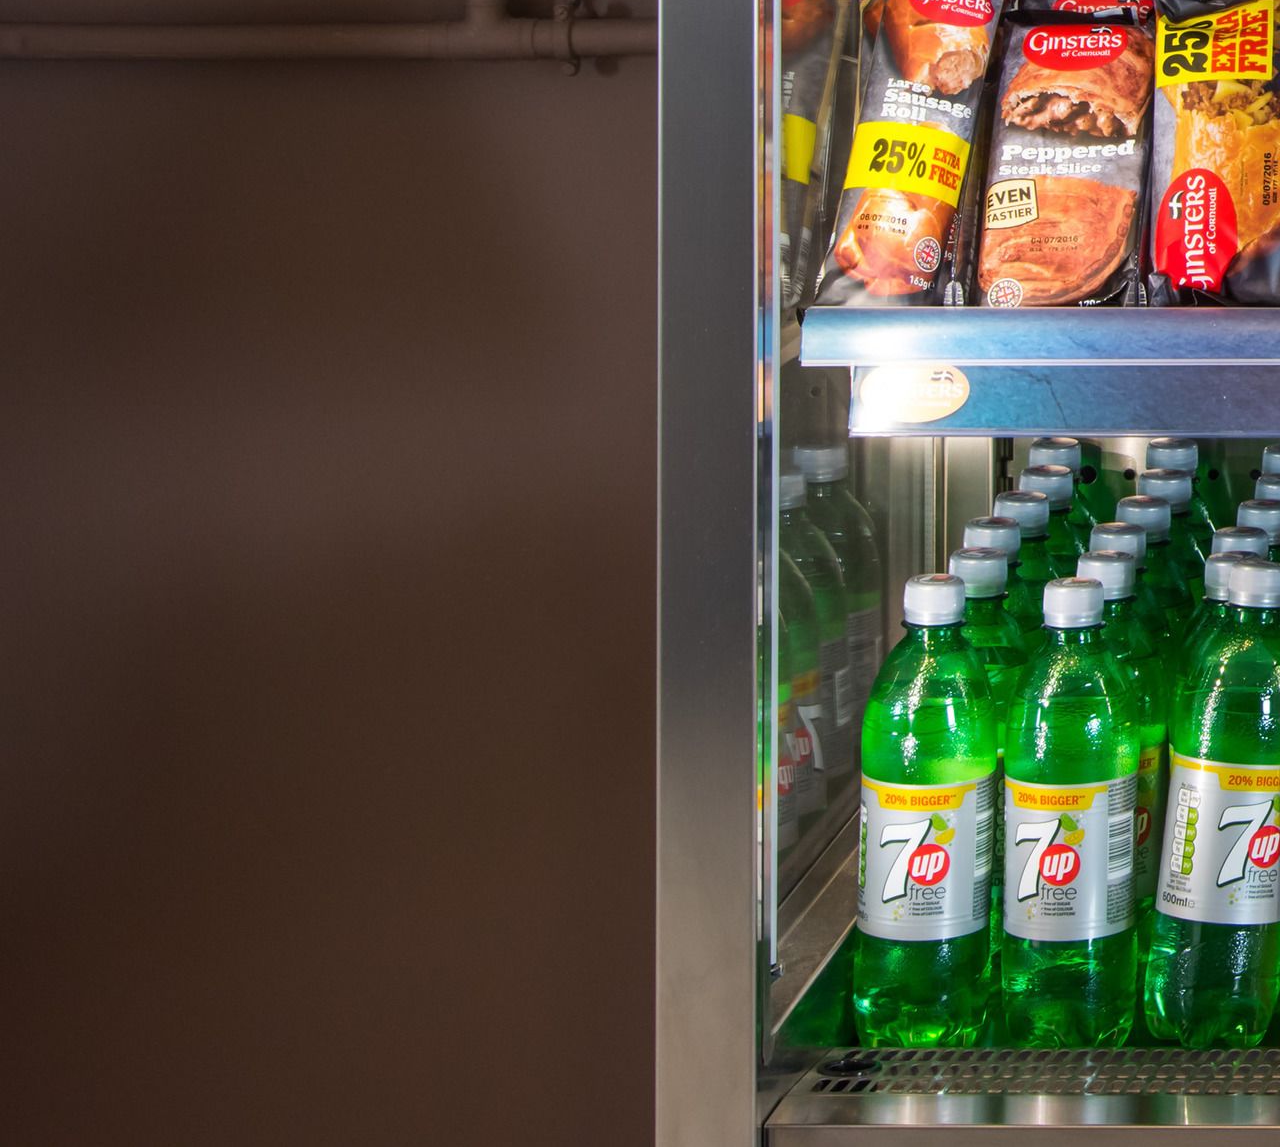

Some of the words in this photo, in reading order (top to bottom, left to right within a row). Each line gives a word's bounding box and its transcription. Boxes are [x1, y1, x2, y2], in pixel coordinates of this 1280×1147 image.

[951, 4, 984, 20] Cornwall
[887, 78, 930, 92] Large
[884, 87, 972, 120] Sausage
[881, 103, 926, 121] Roll
[869, 137, 926, 180] 25%
[1001, 139, 1135, 162] Peppered
[933, 148, 962, 171] EXTRA
[998, 163, 1049, 177] Steak
[1056, 161, 1101, 176] Slice
[987, 184, 1032, 208] EVEN
[986, 207, 1032, 223] TASTIER
[885, 794, 907, 805] 20%
[909, 885, 947, 901] free
[1163, 893, 1188, 907] 600ml
